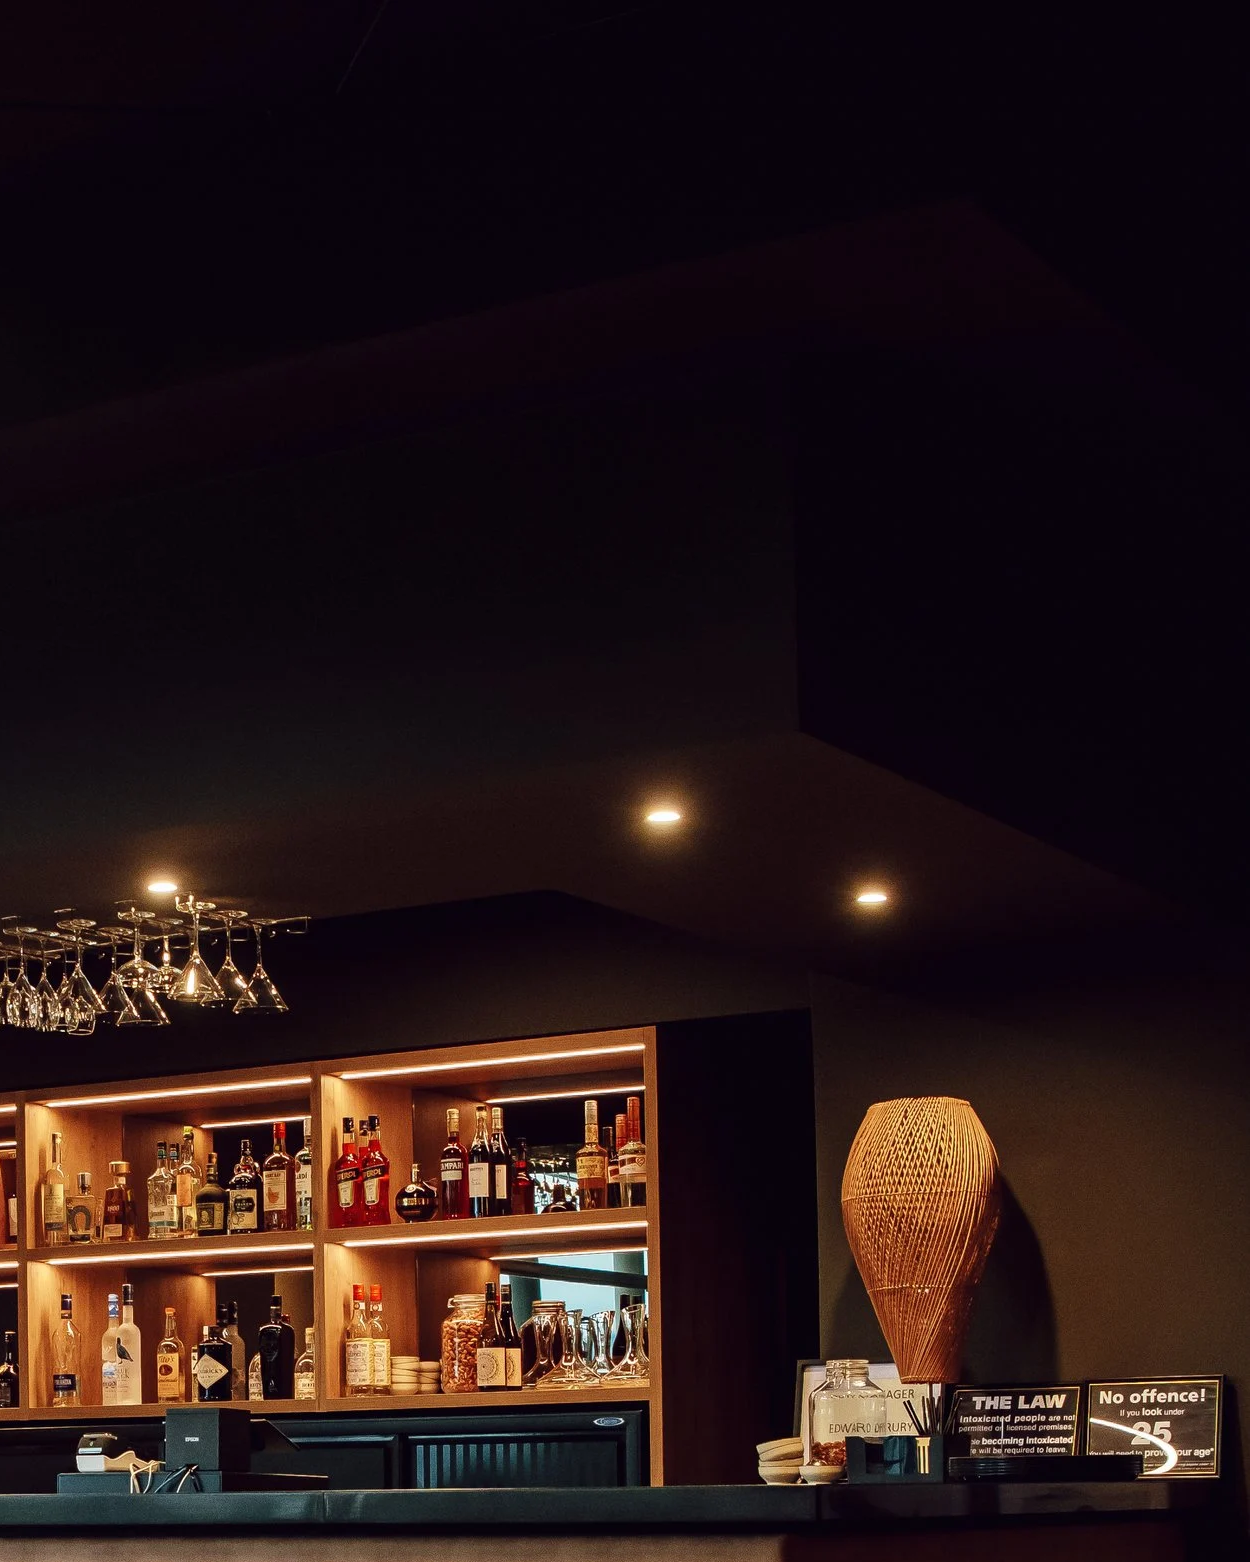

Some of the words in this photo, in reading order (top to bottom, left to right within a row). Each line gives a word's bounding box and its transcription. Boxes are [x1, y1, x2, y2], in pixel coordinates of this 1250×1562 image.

[1099, 1390, 1124, 1404] No
[1130, 1388, 1206, 1404] offence!
[972, 1396, 1012, 1410] THE
[1018, 1394, 1067, 1409] LAW
[1142, 1407, 1162, 1416] look
[1164, 1408, 1185, 1416] under
[960, 1414, 1011, 1423] Intoxicated
[1014, 1413, 1046, 1423] people
[829, 1423, 871, 1434] EDWARD
[958, 1424, 993, 1433] permitted
[1038, 1423, 1074, 1432] premises.
[1131, 1421, 1172, 1445] 25
[981, 1436, 1024, 1446] becoming
[1026, 1435, 1073, 1444] intoxicated
[978, 1446, 991, 1454] will
[992, 1446, 1002, 1454] be
[1004, 1446, 1035, 1455] required
[1176, 1449, 1192, 1457] our
